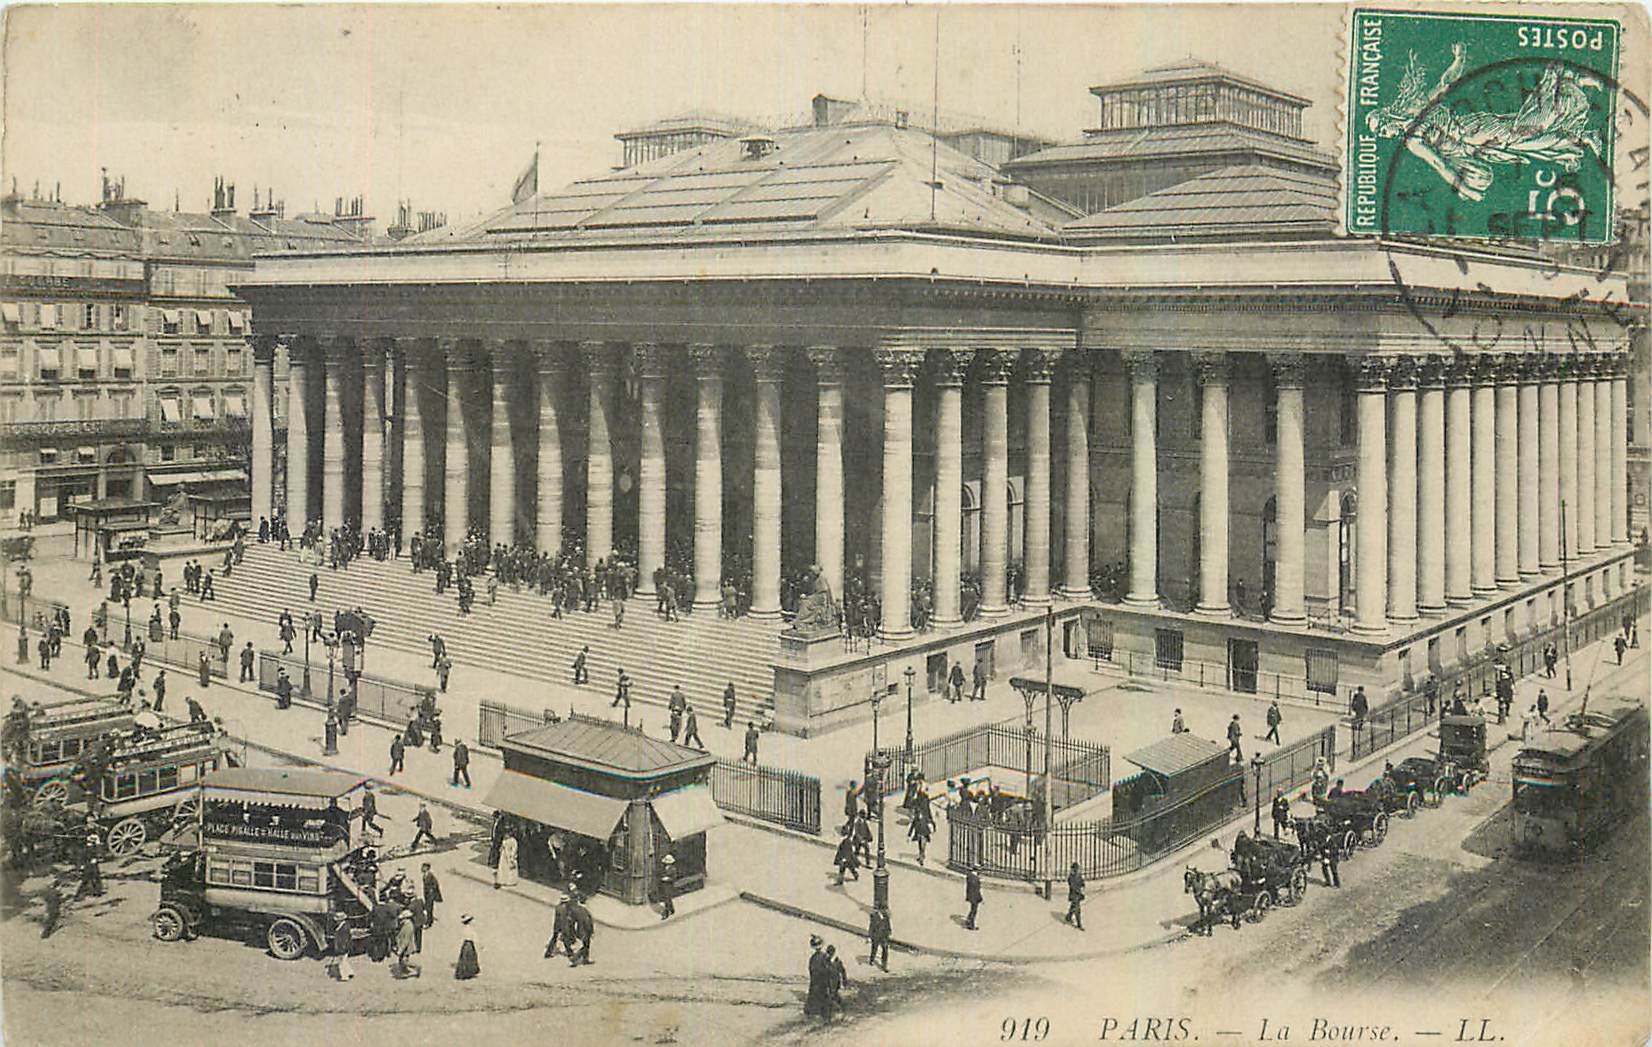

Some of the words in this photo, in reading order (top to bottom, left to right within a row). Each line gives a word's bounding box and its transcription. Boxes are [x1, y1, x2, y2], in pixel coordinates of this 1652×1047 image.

[1517, 26, 1604, 51] POSTES
[1359, 18, 1383, 107] FRANÇAISE
[207, 822, 229, 834] PLACE
[267, 827, 289, 839] HALLE
